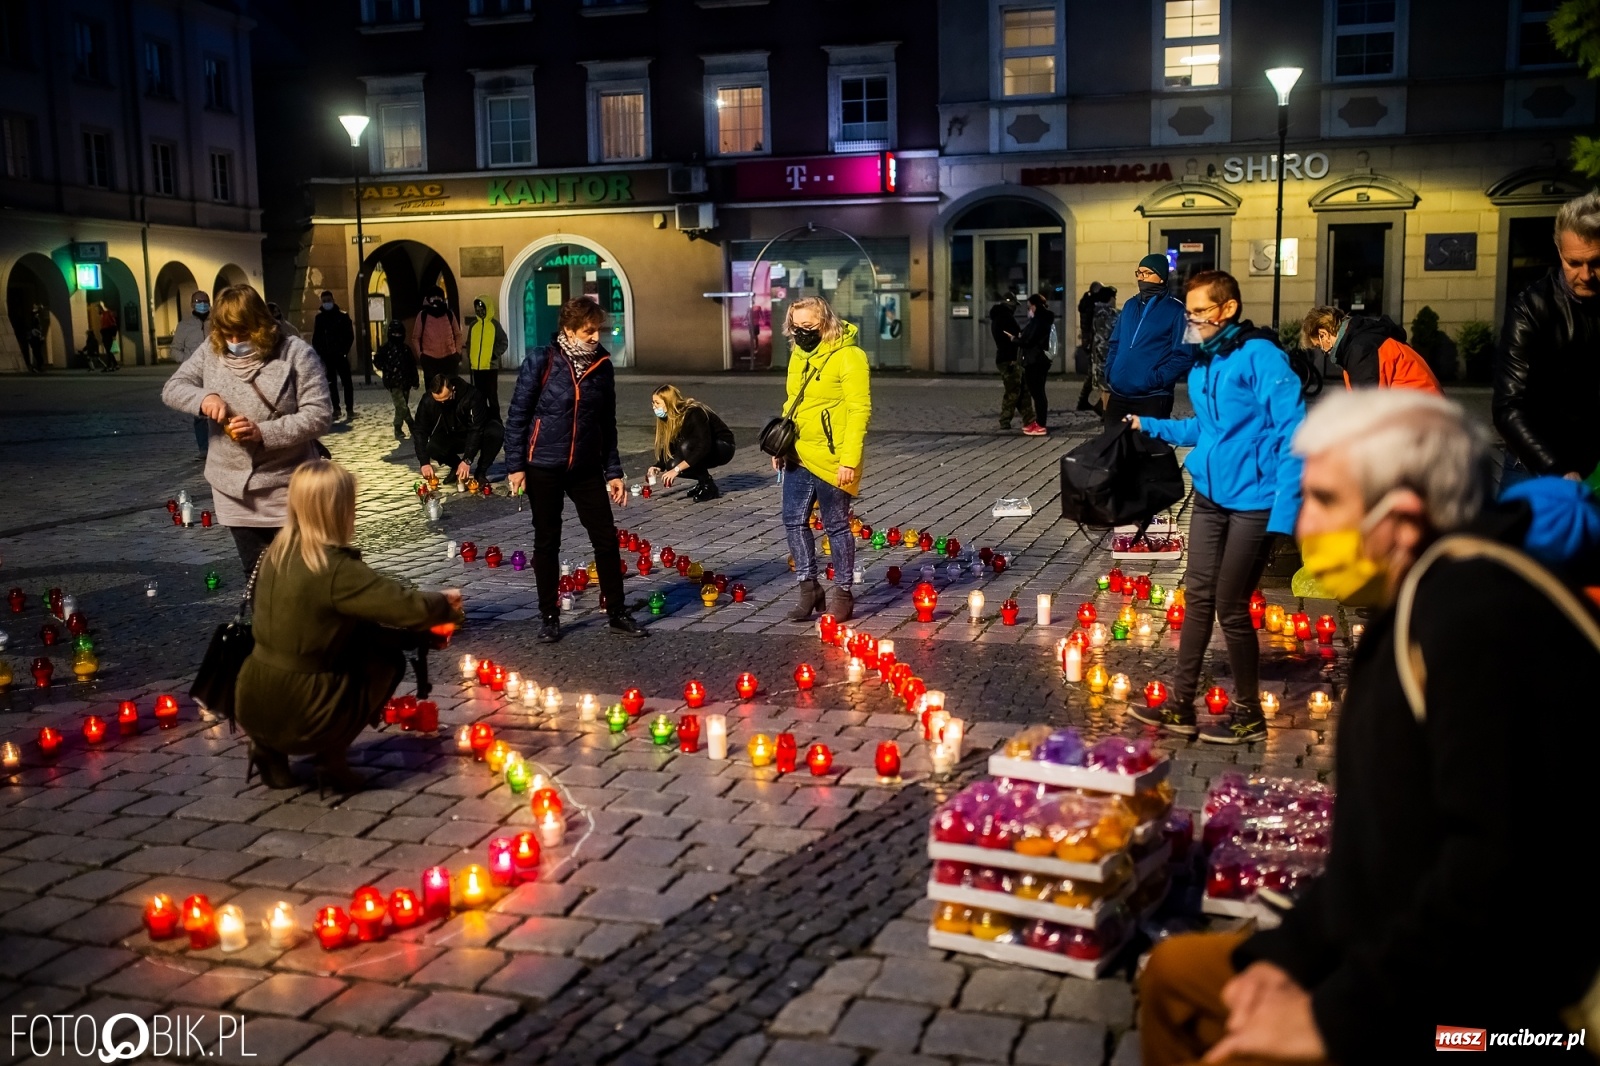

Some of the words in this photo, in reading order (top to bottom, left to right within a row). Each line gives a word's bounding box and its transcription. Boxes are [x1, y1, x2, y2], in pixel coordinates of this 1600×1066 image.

[1021, 162, 1173, 186] RESTAURACJA
[1224, 152, 1329, 183] SHIRO
[349, 184, 444, 200] TABAC
[489, 173, 634, 206] KANTOR
